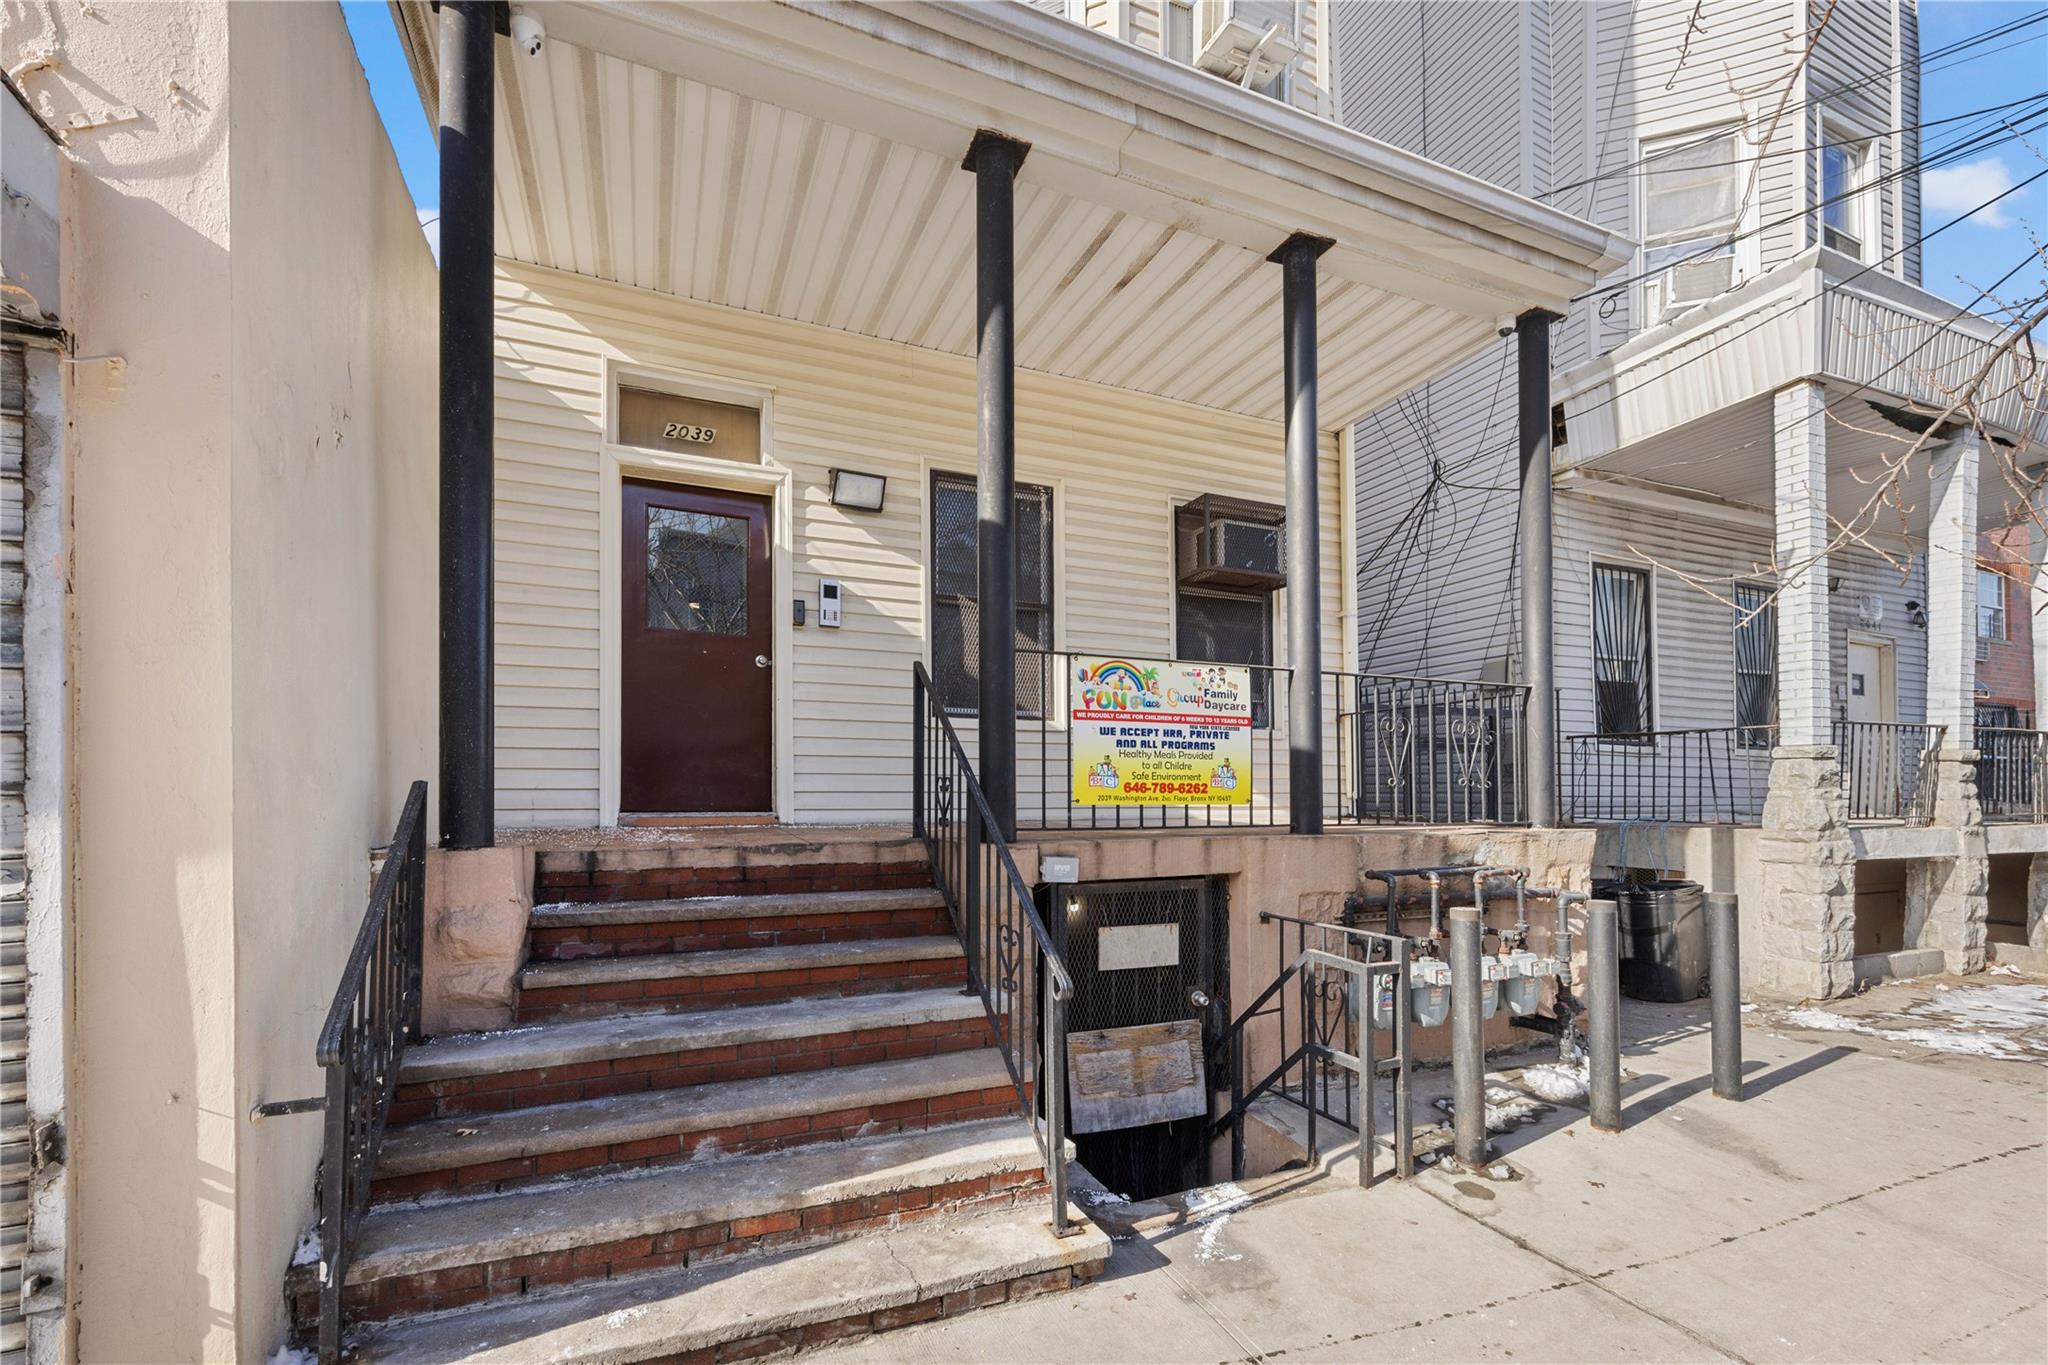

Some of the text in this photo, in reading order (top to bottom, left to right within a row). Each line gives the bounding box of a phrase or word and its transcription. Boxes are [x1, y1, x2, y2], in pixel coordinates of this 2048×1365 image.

[665, 424, 714, 441] 2039
[1082, 688, 1161, 710] FUN Place
[1167, 688, 1204, 708] Group
[1204, 688, 1238, 701] Family
[1204, 700, 1247, 712] Daycare
[1087, 711, 1115, 719] PROUDLY
[1099, 726, 1230, 740] WE ACCEPT HRA, PRIVATE
[1116, 739, 1216, 750] AND ALL PROGRAMS
[1119, 749, 1214, 760] Healthy Meals Provided
[1152, 761, 1163, 769] all
[1164, 761, 1192, 770] Childre
[1131, 771, 1202, 781] Safe Environment
[1123, 782, 1208, 794] 646-789-6262
[1113, 795, 1147, 803] Washington
